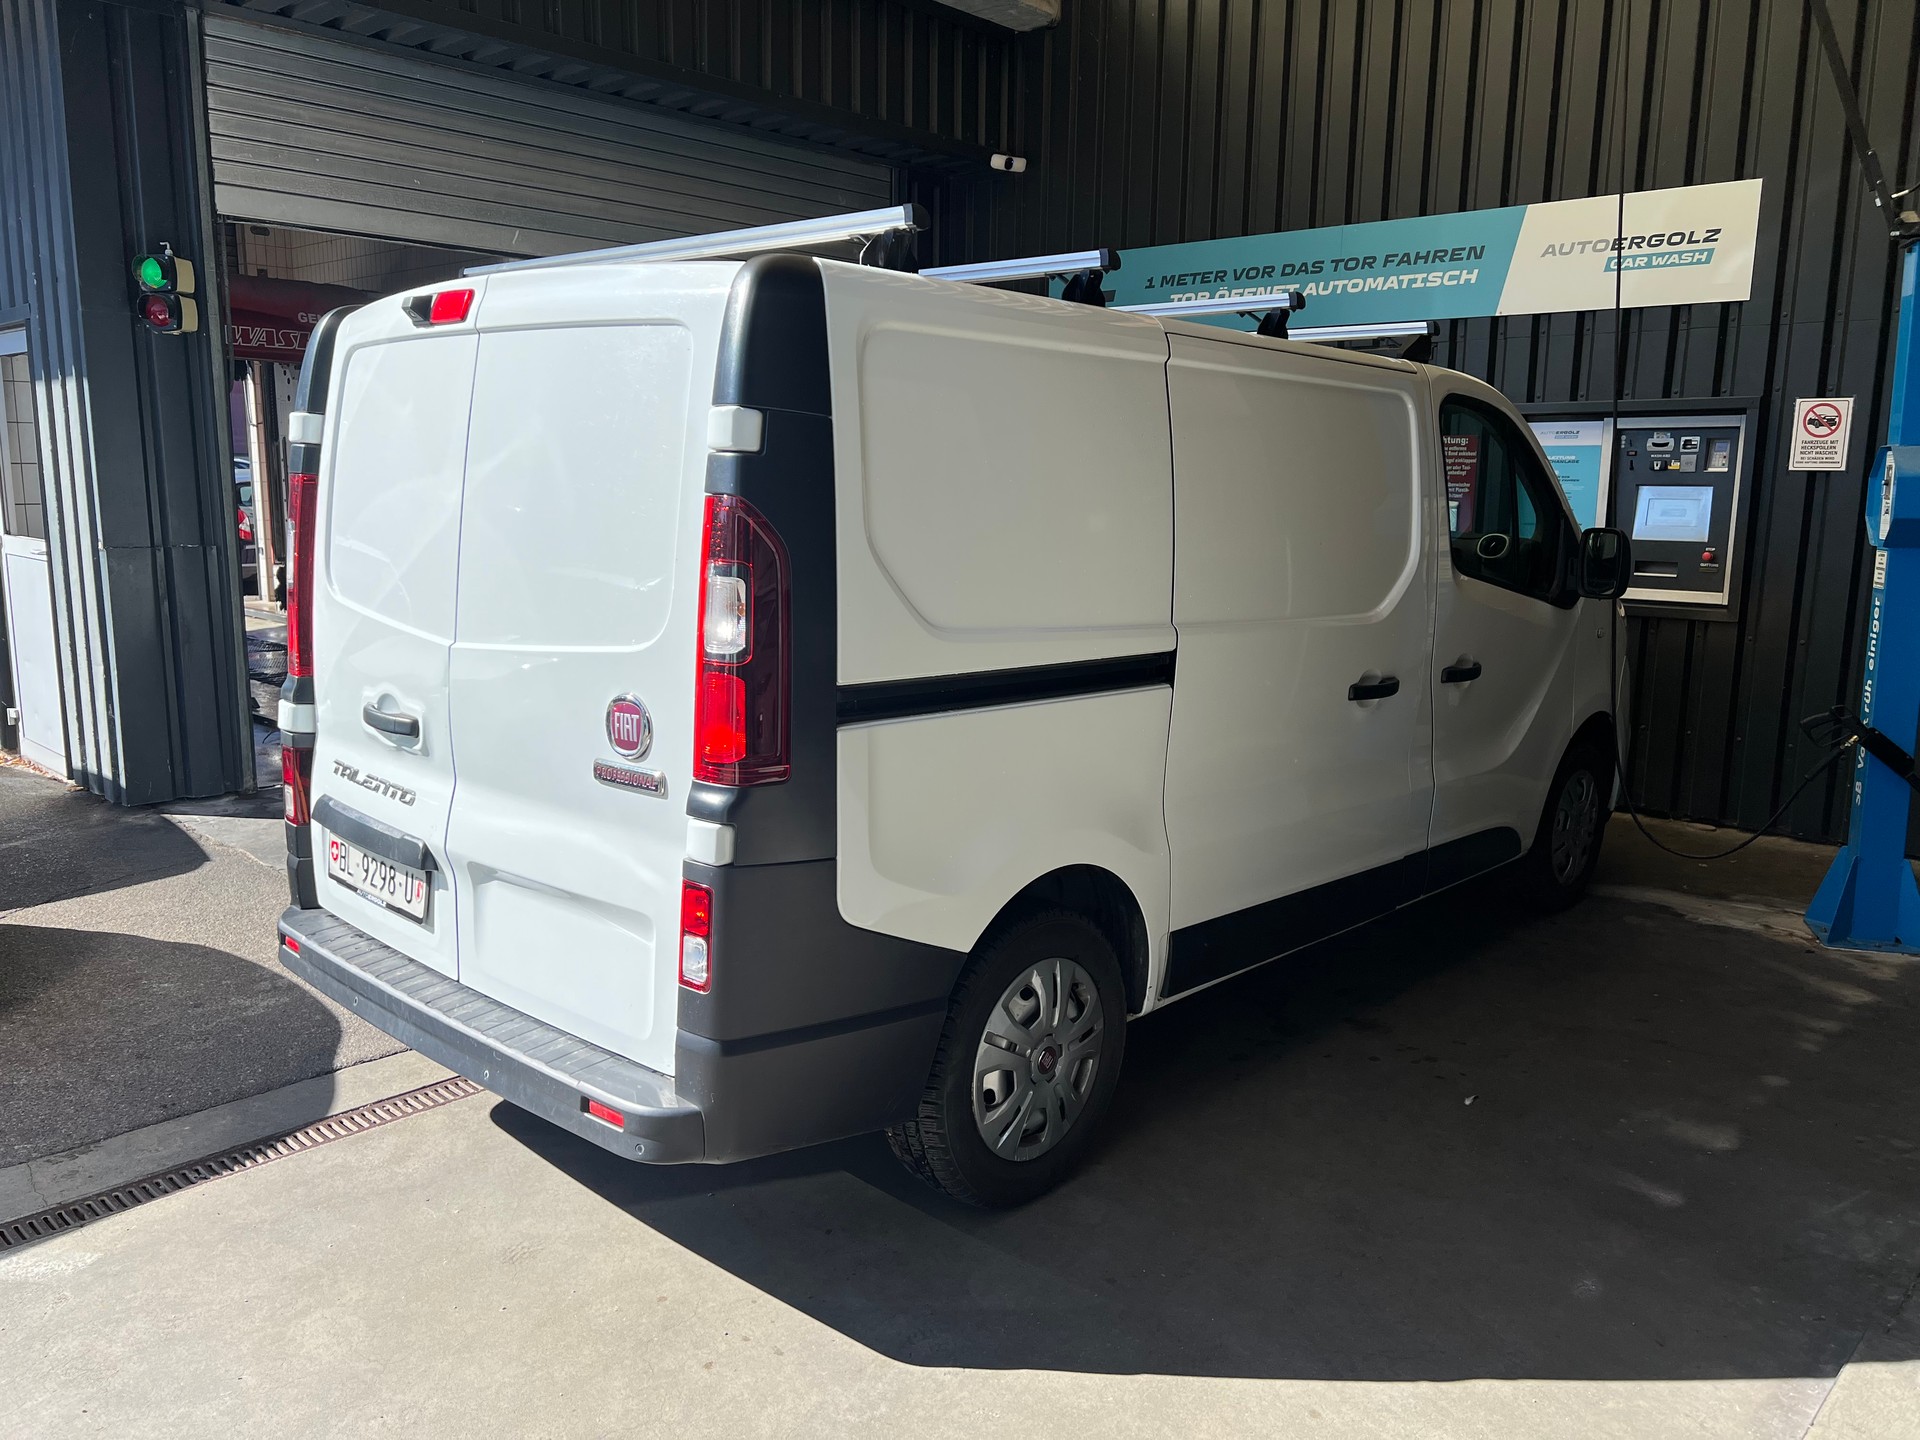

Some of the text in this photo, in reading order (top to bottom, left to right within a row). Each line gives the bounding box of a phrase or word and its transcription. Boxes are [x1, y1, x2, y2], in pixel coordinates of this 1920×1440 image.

[1540, 228, 1722, 258] AUTOERGOLZ
[1144, 245, 1486, 289] 1 METER VOR DAS TOR FAHREN
[1609, 251, 1708, 270] CAR WASH
[1303, 269, 1479, 297] AUTOMATISCH
[614, 711, 640, 743] FIAT
[333, 758, 416, 807] TALENTO
[595, 764, 657, 791] PROFESSIONAL
